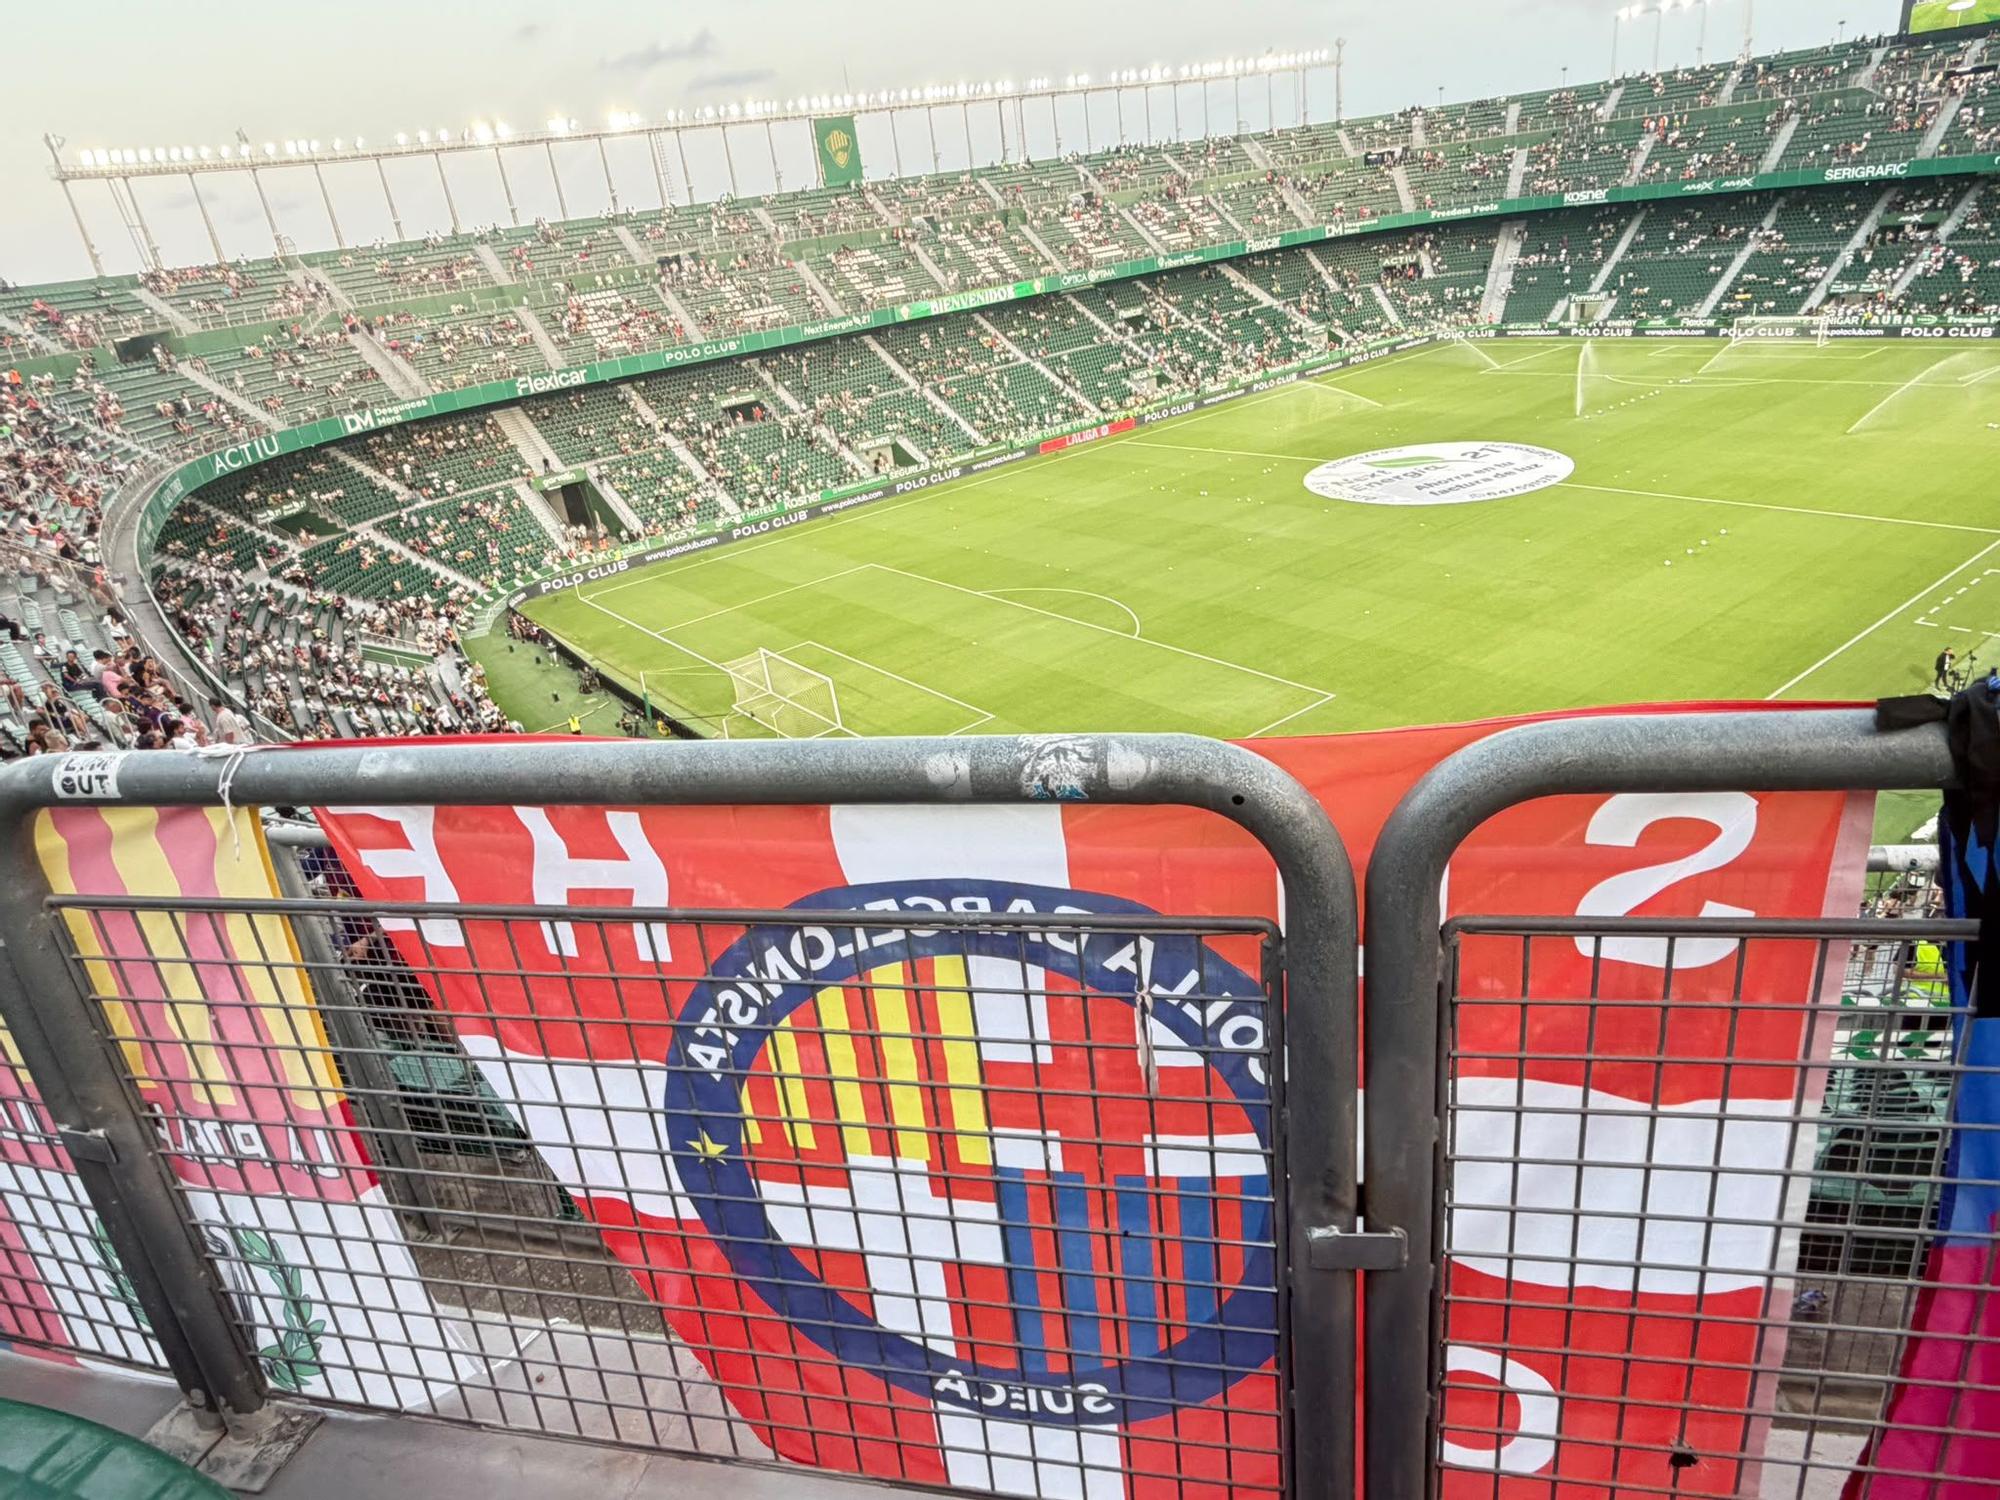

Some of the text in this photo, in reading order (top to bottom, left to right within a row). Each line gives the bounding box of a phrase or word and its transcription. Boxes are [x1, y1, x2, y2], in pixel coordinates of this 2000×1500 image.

[1824, 161, 1908, 182] SERIGRAFIC
[1431, 203, 1499, 219] Freedom Pools
[1382, 254, 1417, 266] ACTIU
[930, 286, 1015, 315] BIENVENIDOS
[804, 322, 824, 337] Next
[862, 315, 871, 325] 21
[1870, 314, 1914, 325] AURA
[1467, 329, 1496, 339] CLUB
[1571, 327, 1633, 337] POLO CLUB
[1719, 327, 1795, 337] POLO CLUB
[1901, 327, 1993, 337] POLO CLUB
[665, 340, 738, 363] POLO CLUB
[516, 367, 587, 396] Flexicar
[1252, 373, 1298, 392] POLO CLUB
[343, 409, 375, 434] DM
[1144, 408, 1169, 423] POLO
[1170, 402, 1195, 416] CLUB
[1065, 428, 1098, 446] LALIGA
[213, 435, 280, 475] ACTIU
[895, 477, 928, 493] POLO
[930, 468, 960, 484] CLUB
[732, 510, 808, 539] POLO CLUB
[645, 536, 718, 562] www.poloclub.com
[540, 560, 629, 593] POLO CLUB
